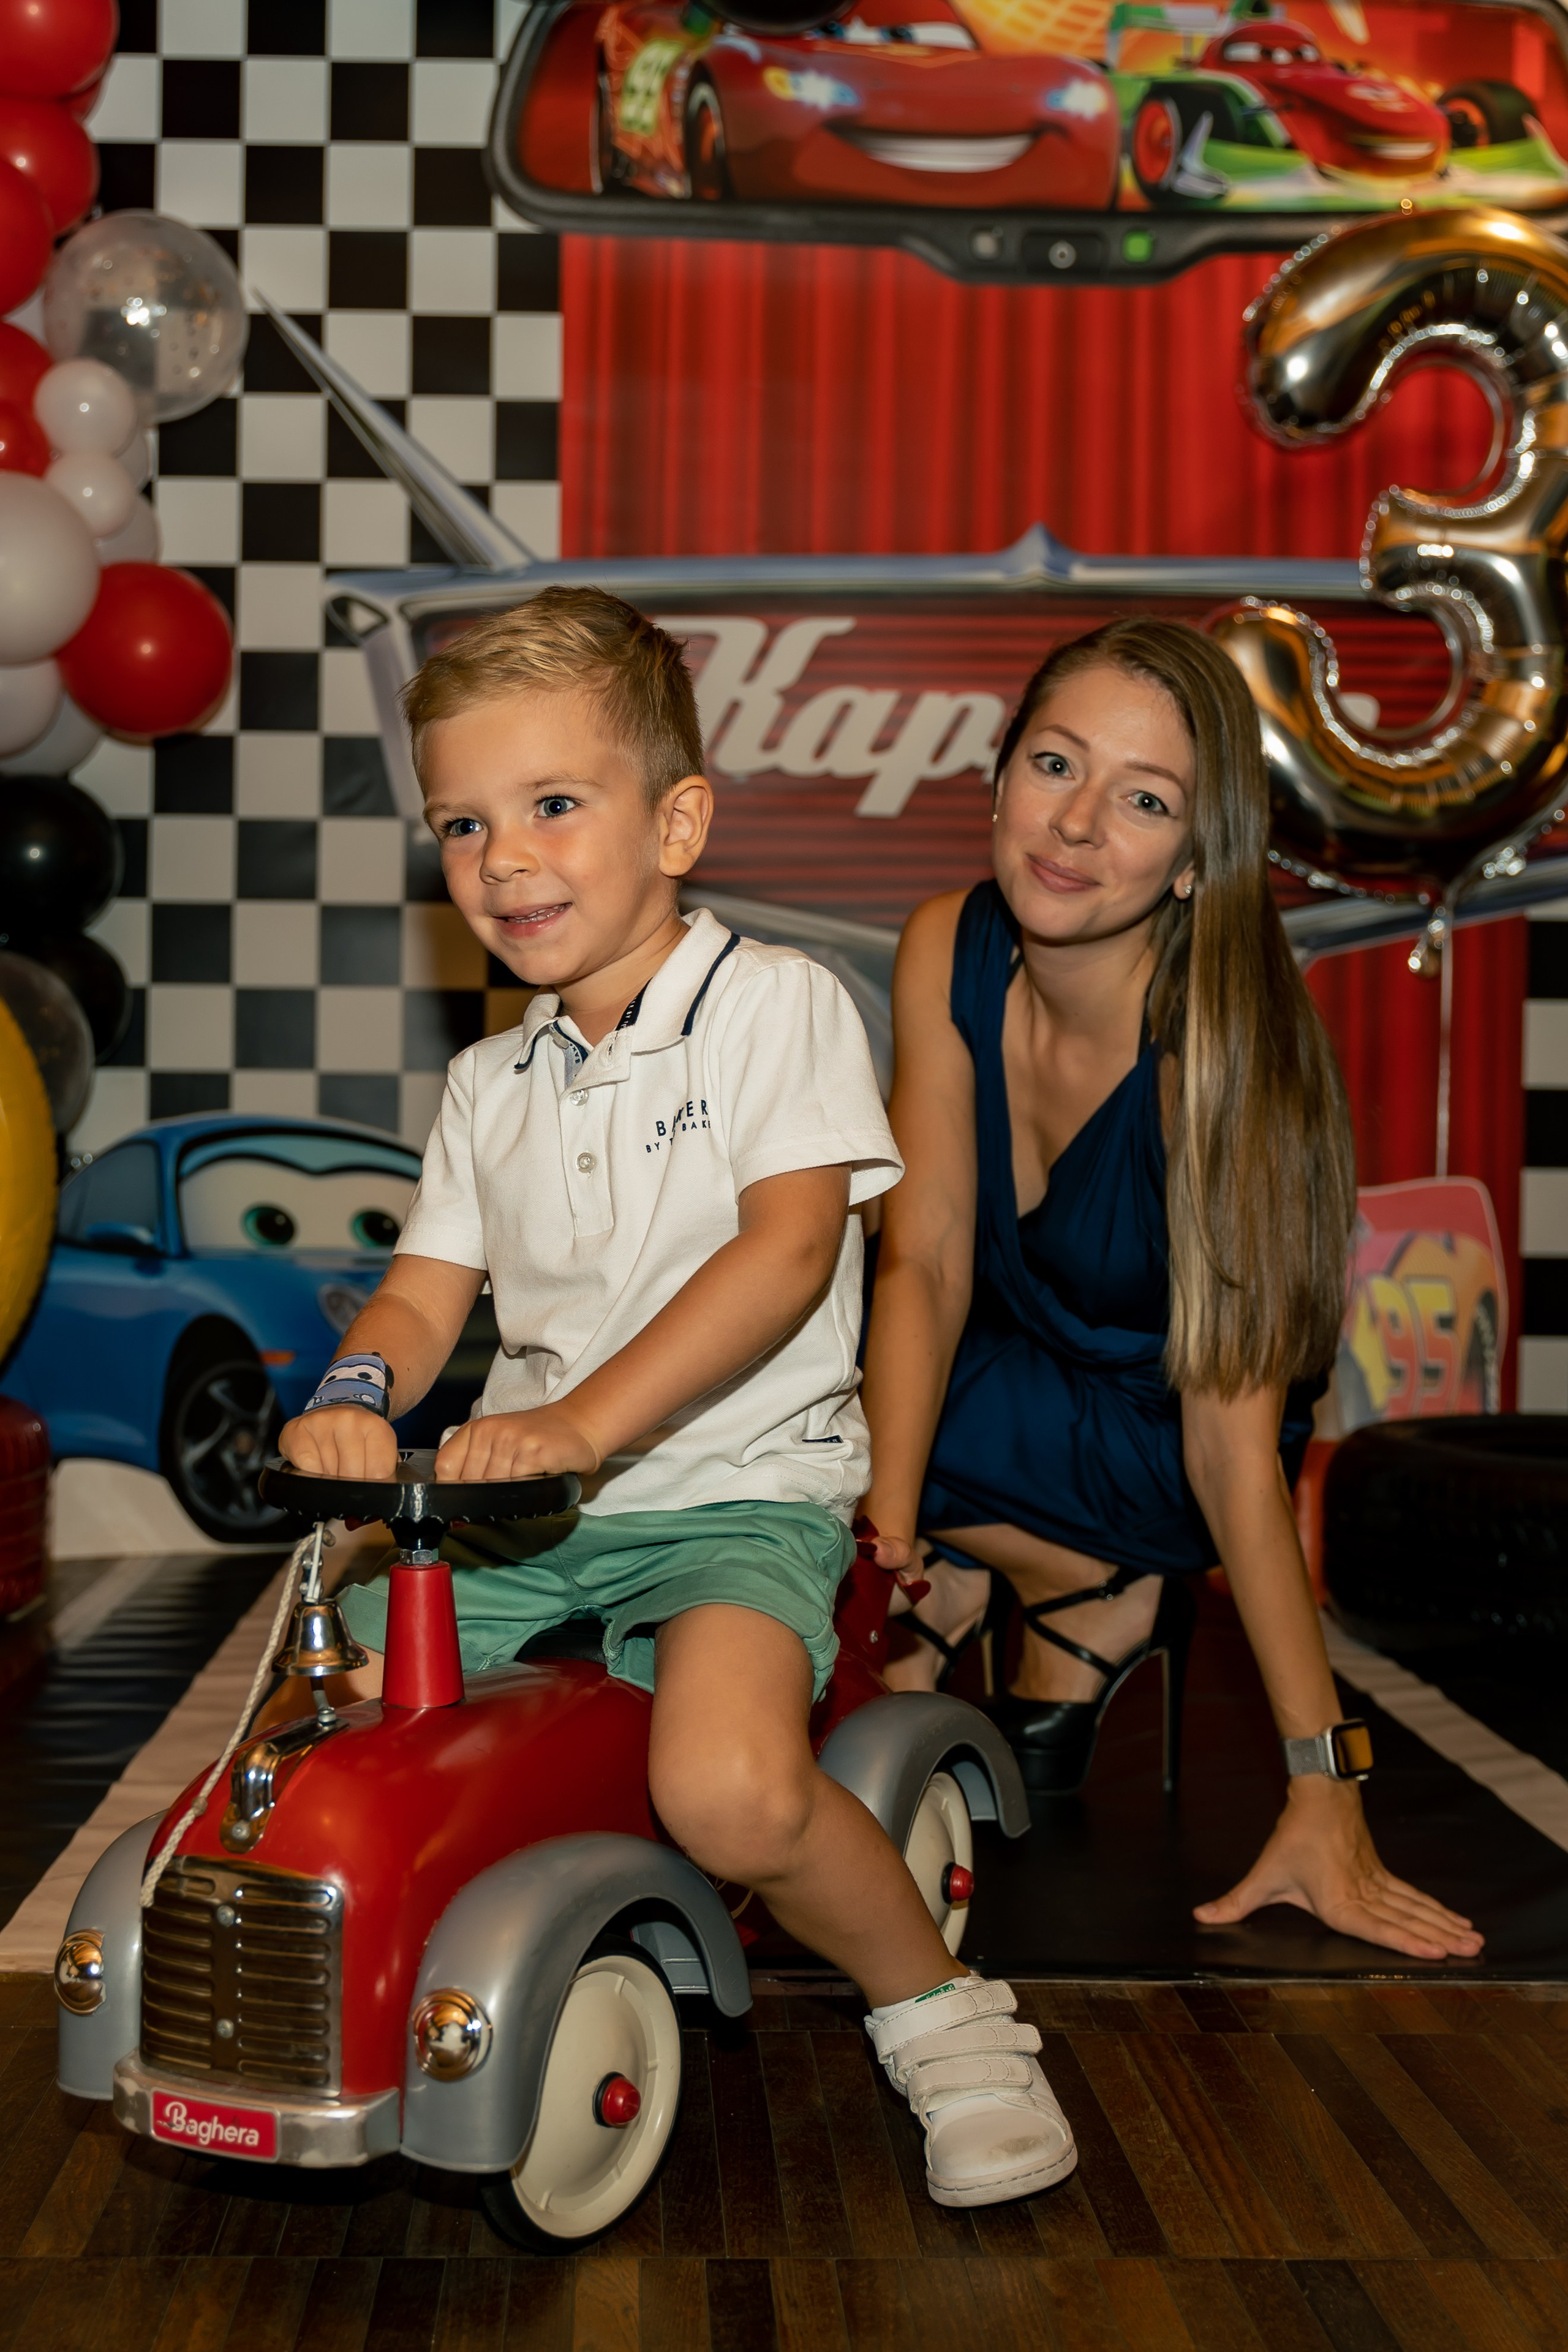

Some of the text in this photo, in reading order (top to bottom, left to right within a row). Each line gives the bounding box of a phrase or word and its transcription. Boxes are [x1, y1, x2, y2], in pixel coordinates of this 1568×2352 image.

[653, 615, 996, 818] Kap
[645, 1141, 660, 1153] BY
[161, 2101, 260, 2146] Baghera
